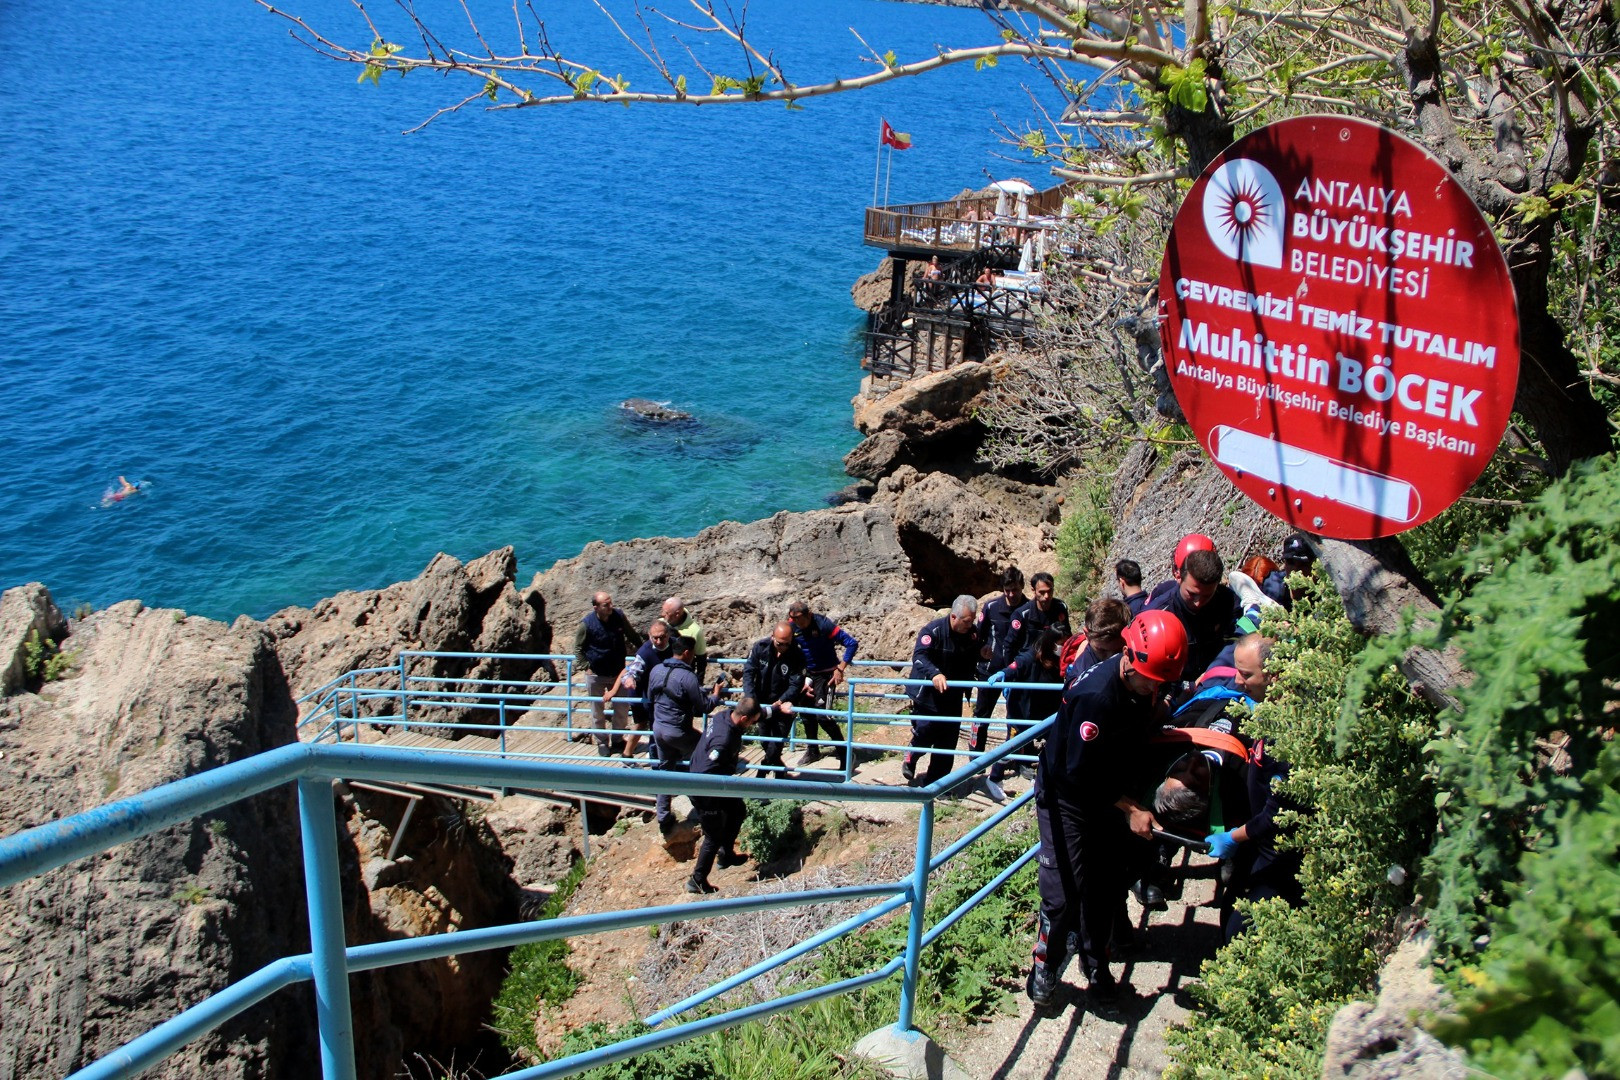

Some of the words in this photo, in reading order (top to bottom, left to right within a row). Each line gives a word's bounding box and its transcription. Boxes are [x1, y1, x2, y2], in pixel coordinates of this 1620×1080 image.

[1294, 177, 1412, 218] ANTALYA
[1291, 249, 1429, 298] BELEDİYESİ
[1293, 209, 1474, 268] BÜYÜKŞEHİR
[1176, 277, 1293, 321] ÇEVREMİZİ
[1298, 304, 1373, 340] TEMİZ
[1378, 321, 1496, 368] TUTALIM
[1176, 360, 1233, 389] Antalya
[1237, 375, 1324, 413] Büyükşehir
[1328, 400, 1400, 436] Belediye
[1404, 421, 1476, 456] Başkanı
[1178, 318, 1329, 386] Muhittin
[1337, 354, 1483, 427] BÖCEK
